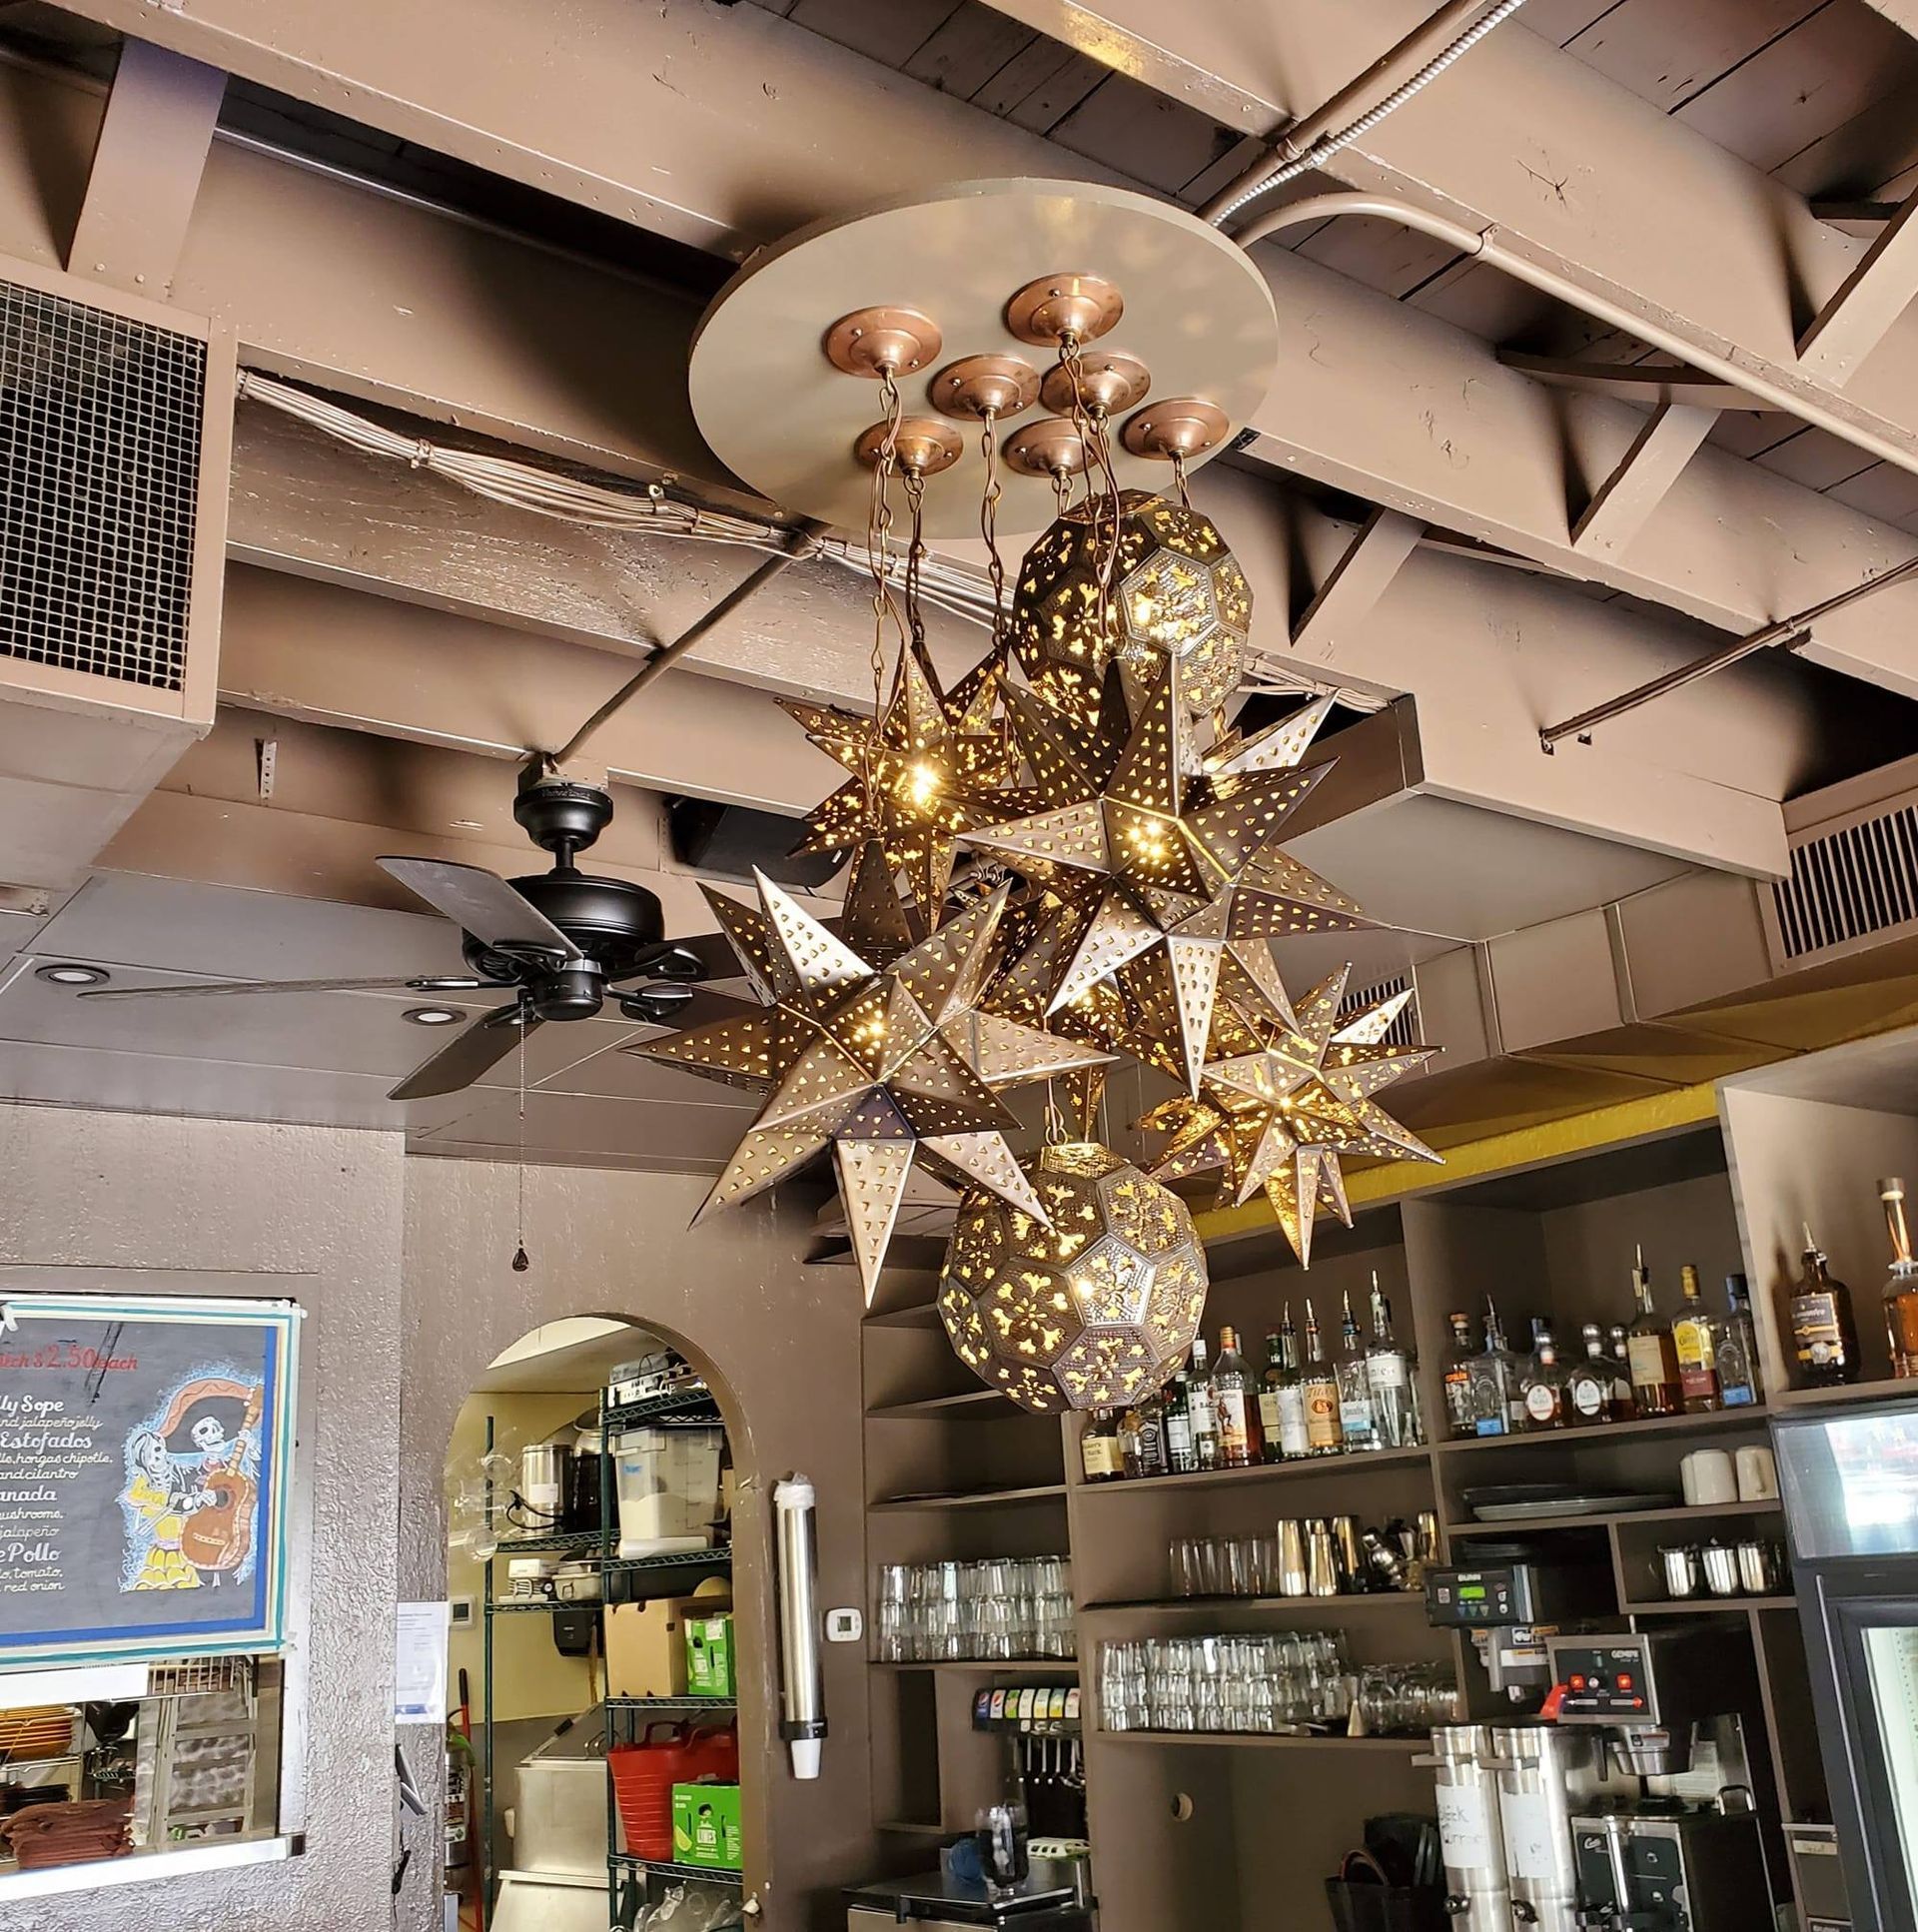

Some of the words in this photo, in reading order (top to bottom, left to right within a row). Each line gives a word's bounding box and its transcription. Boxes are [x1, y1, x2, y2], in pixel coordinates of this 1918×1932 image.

[21, 1395, 64, 1418] Sope
[0, 1431, 92, 1454] Estofados
[24, 1467, 79, 1479] cilantro
[7, 1541, 62, 1563] Pollo
[4, 1581, 28, 1593] red
[30, 1579, 66, 1591] onion
